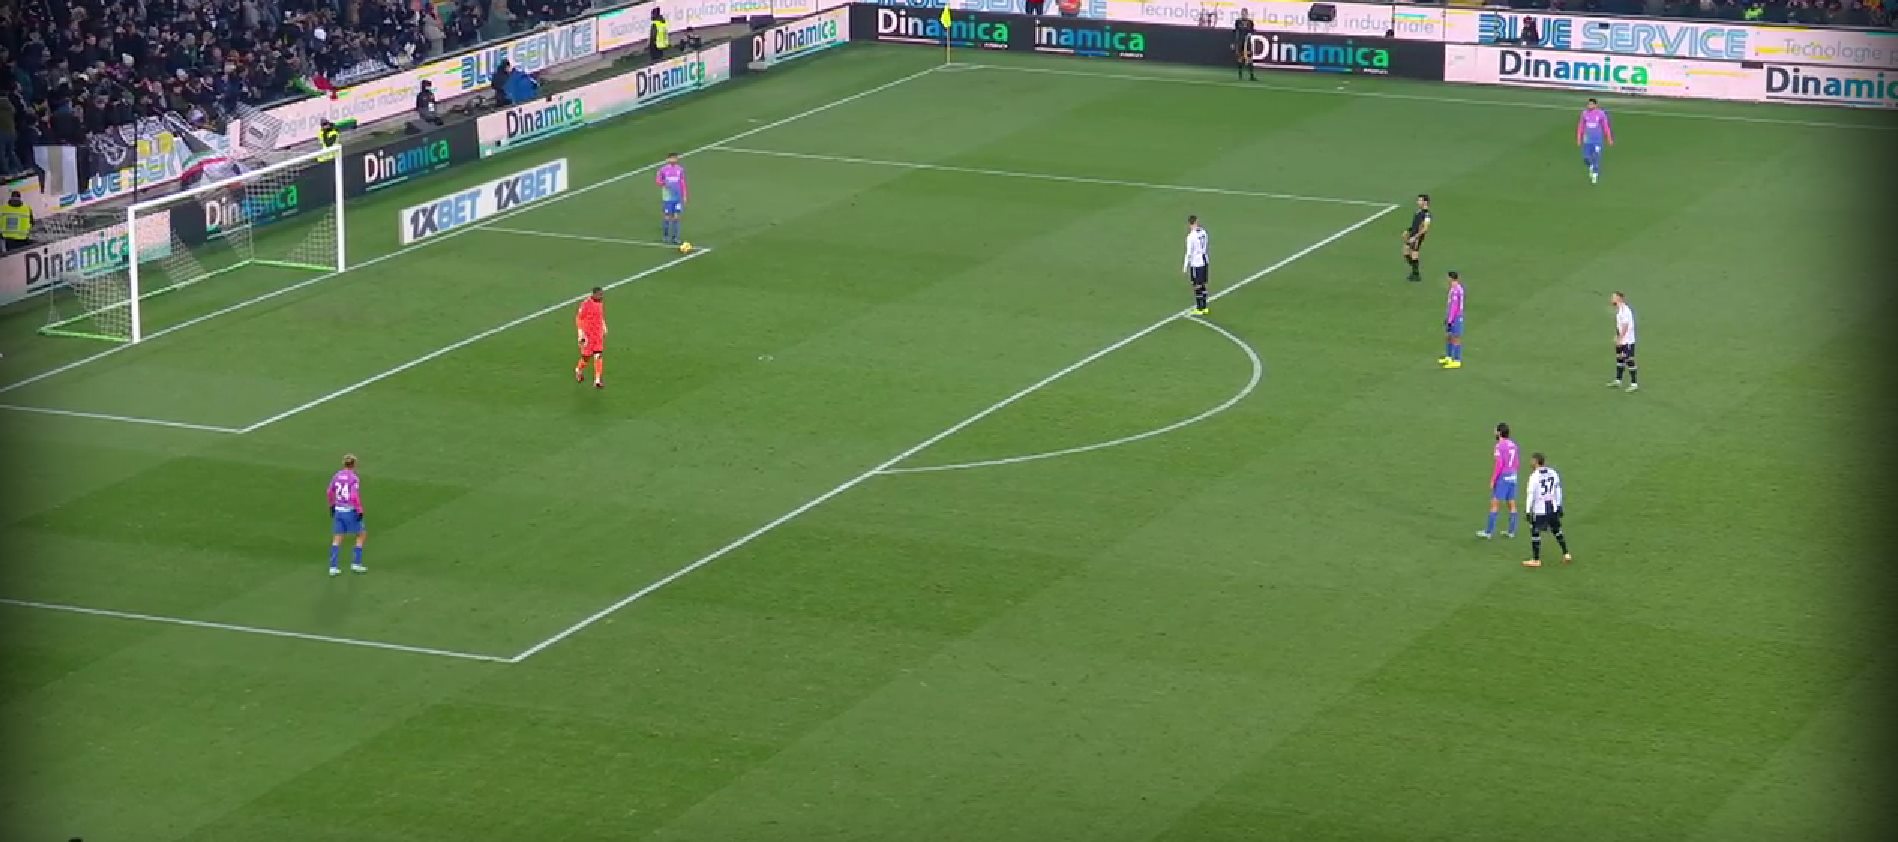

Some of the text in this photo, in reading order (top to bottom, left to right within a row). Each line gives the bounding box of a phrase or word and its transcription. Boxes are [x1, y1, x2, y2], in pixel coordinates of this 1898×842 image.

[775, 17, 837, 54] Dinamica
[1140, 2, 1224, 21] Tecnologe
[1344, 14, 1435, 34] indusriale
[1250, 34, 1390, 68] Dinamica
[1582, 20, 1749, 60] SERVICE
[635, 57, 706, 99] Dinamica
[1500, 50, 1648, 85] Dinamica
[506, 96, 583, 139] Dinamica
[364, 137, 449, 184] Dinamica
[410, 162, 561, 240] 1XBET 1XBET
[1508, 449, 1516, 467] 7
[334, 482, 349, 501] 24
[1538, 476, 1555, 496] 37
